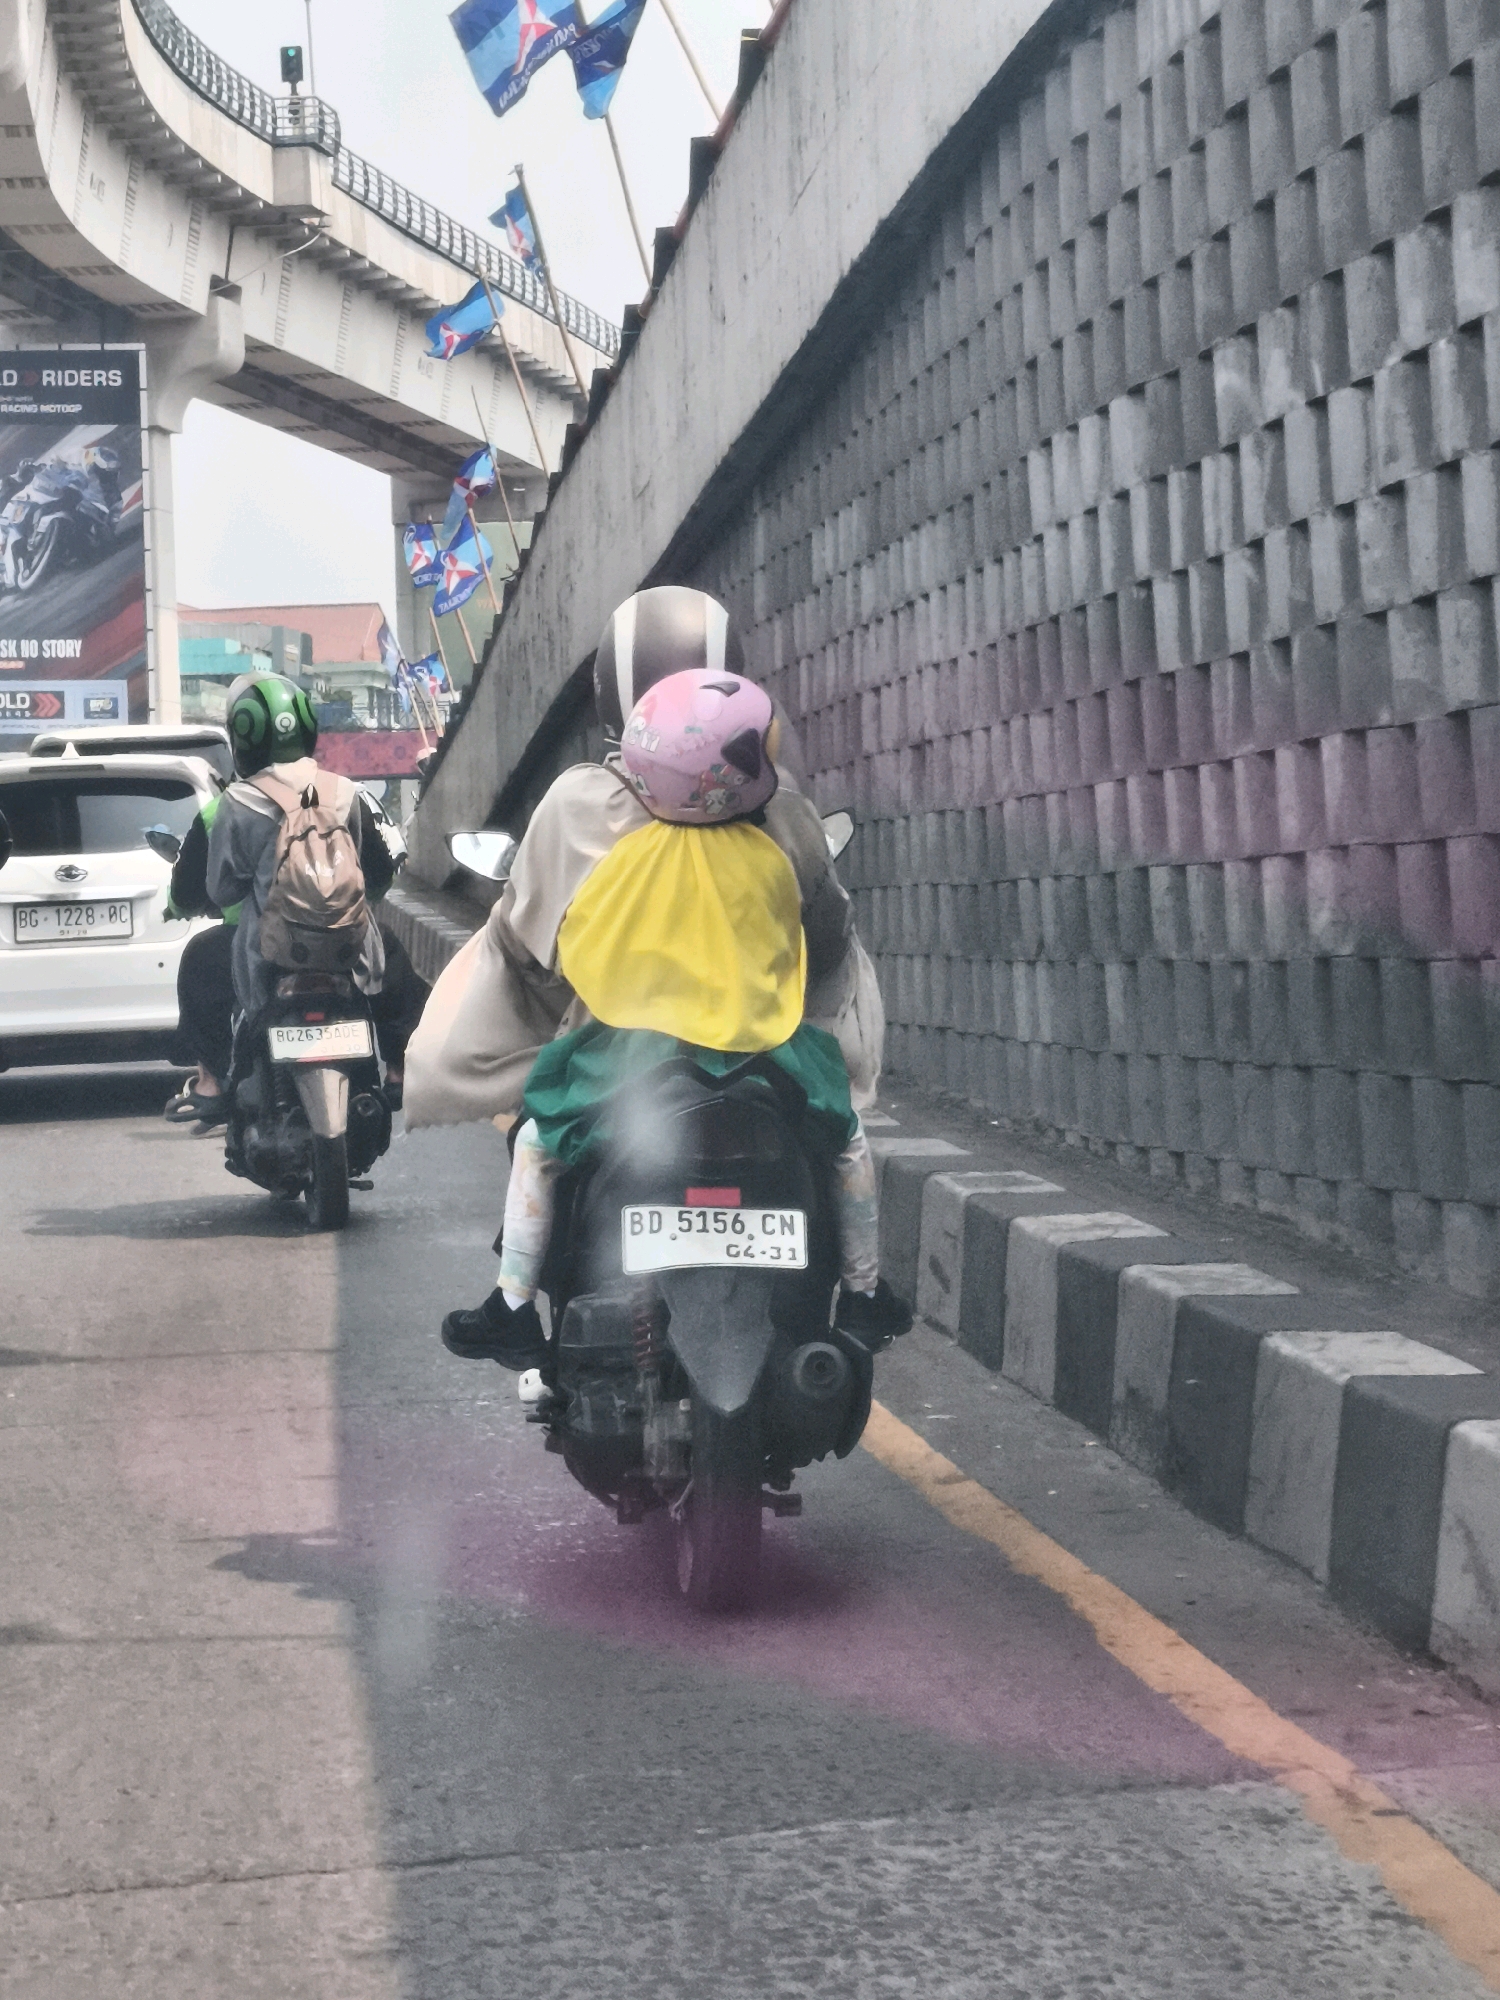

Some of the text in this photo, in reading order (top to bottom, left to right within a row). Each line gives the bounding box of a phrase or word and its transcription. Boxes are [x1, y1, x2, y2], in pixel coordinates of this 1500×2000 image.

[0, 369, 122, 387] D RIDERS
[1, 403, 82, 413] RACING MOTOGP
[20, 639, 38, 659] NO
[42, 639, 82, 659] STORY
[19, 909, 39, 928] BG
[55, 907, 95, 927] 1228
[630, 1210, 795, 1236] BD 5156 CN
